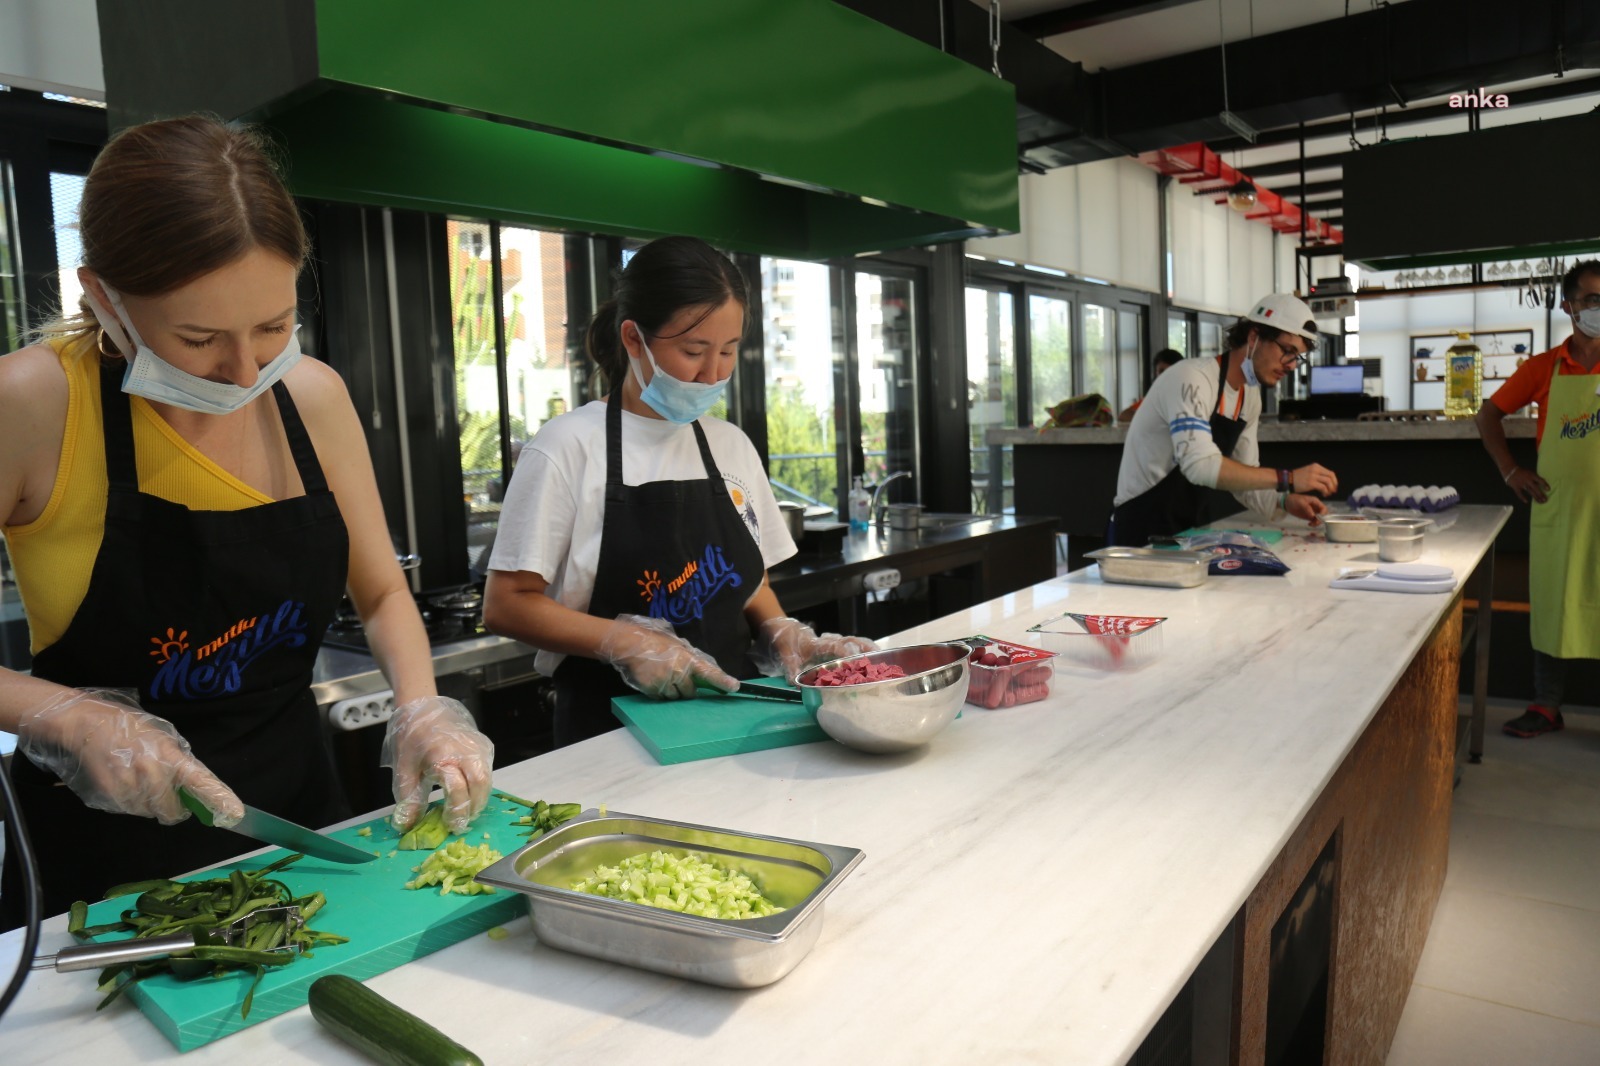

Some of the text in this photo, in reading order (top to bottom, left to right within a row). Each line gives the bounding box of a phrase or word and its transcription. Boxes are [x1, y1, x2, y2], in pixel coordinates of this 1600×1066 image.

[667, 560, 699, 594] mutlu
[150, 599, 308, 701] Mezitli
[196, 616, 258, 661] mutlu
